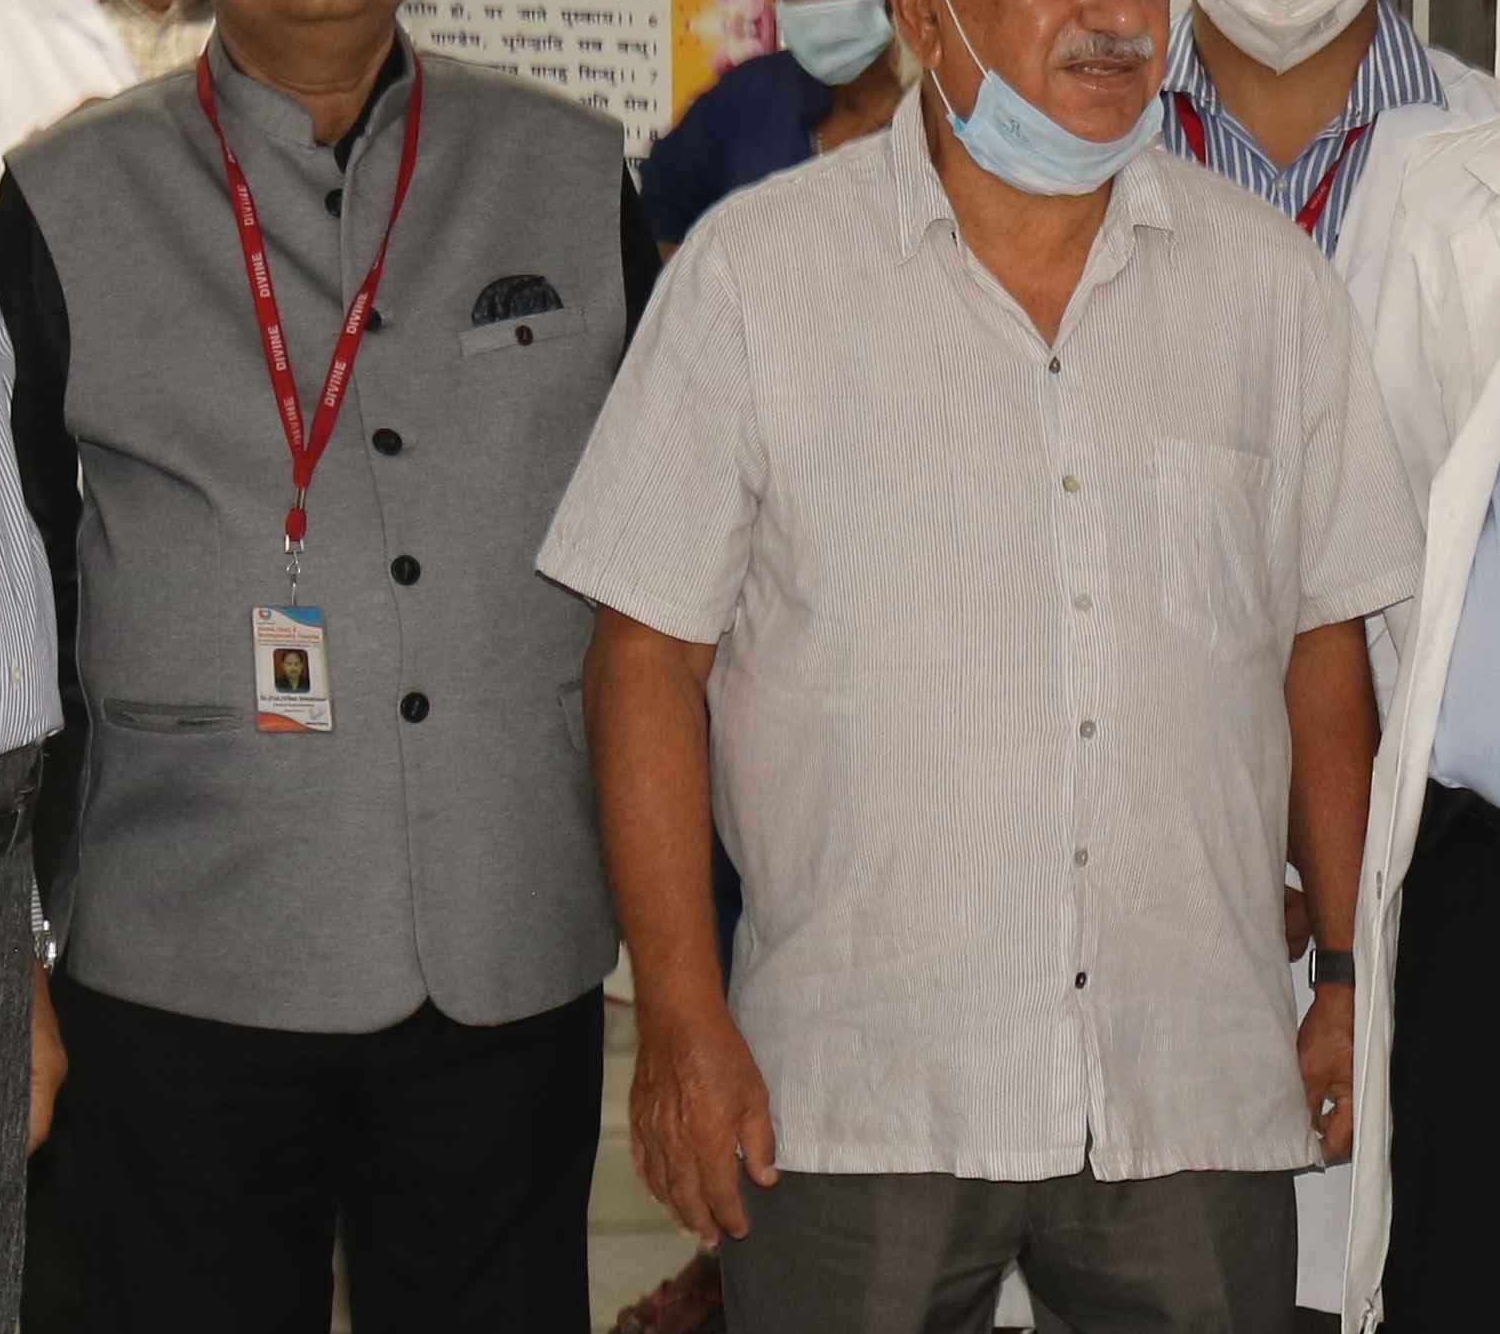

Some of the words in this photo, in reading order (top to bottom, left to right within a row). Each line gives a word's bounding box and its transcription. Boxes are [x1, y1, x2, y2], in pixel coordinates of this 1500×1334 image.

[252, 251, 271, 298] DIVINE
[267, 324, 287, 371] DIVINE
[323, 360, 347, 407] DIVINE
